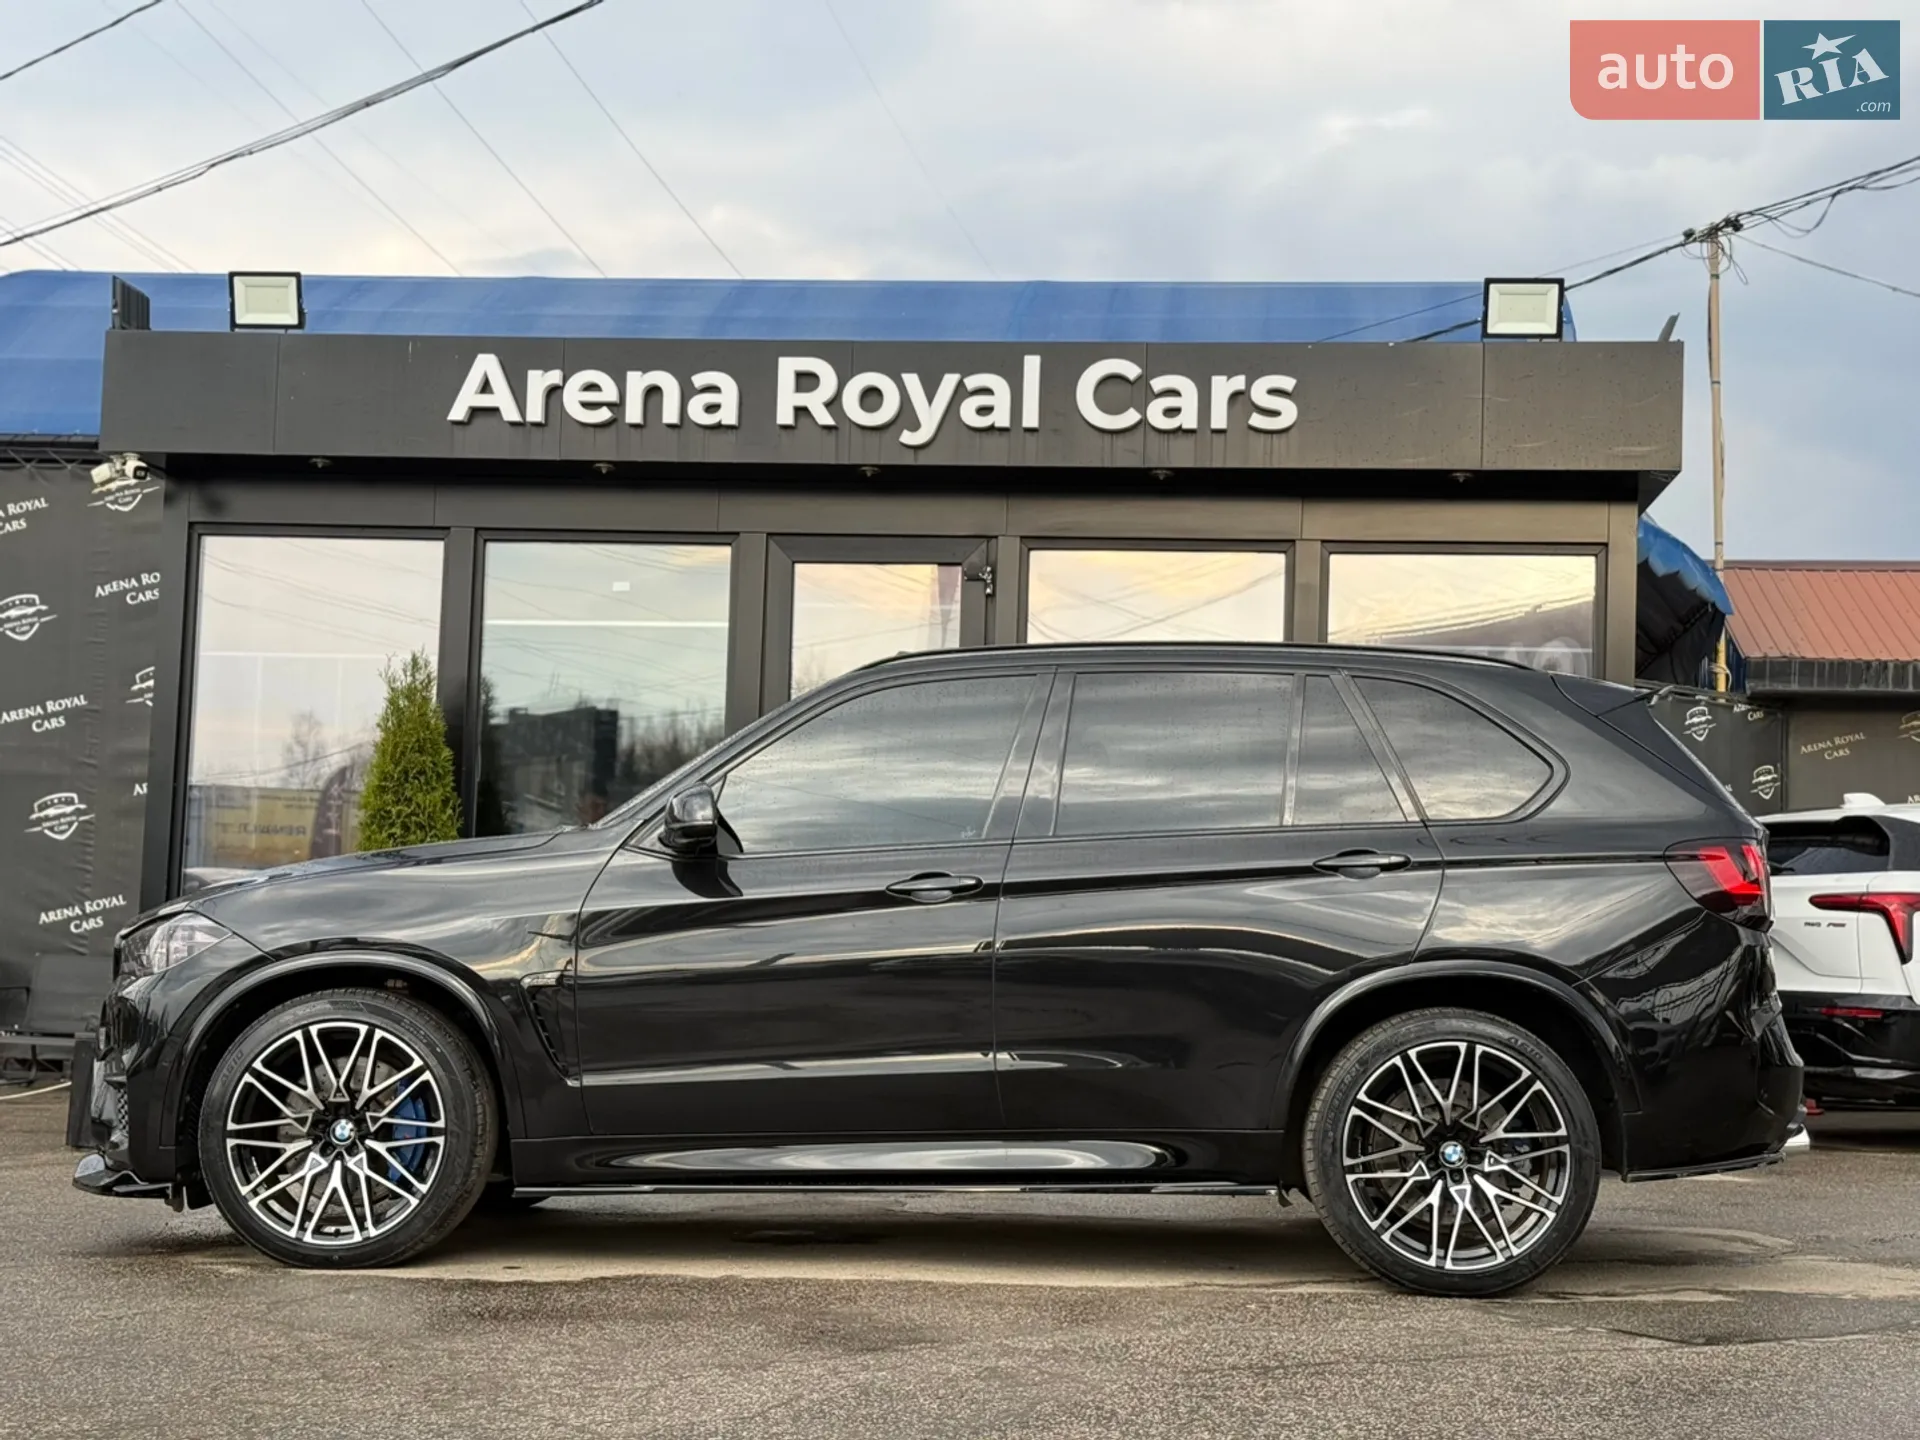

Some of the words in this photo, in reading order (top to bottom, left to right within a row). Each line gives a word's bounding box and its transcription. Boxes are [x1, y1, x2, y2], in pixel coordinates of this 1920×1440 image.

[447, 353, 740, 427] Arena
[776, 354, 1041, 448] Royal
[1075, 358, 1299, 432] Cars
[6, 497, 50, 516] ROYAL
[95, 577, 139, 598] ARENA
[126, 587, 160, 605] CARS
[0, 704, 45, 724] ARENA
[45, 694, 88, 713] ROYAL
[31, 716, 66, 732] CARS
[1800, 739, 1833, 755] ARENA
[1833, 732, 1867, 746] ROYAL
[1824, 747, 1850, 760] CARS
[39, 905, 83, 925] ARENA
[84, 894, 127, 914] ROYAL
[69, 916, 104, 933] CARS
